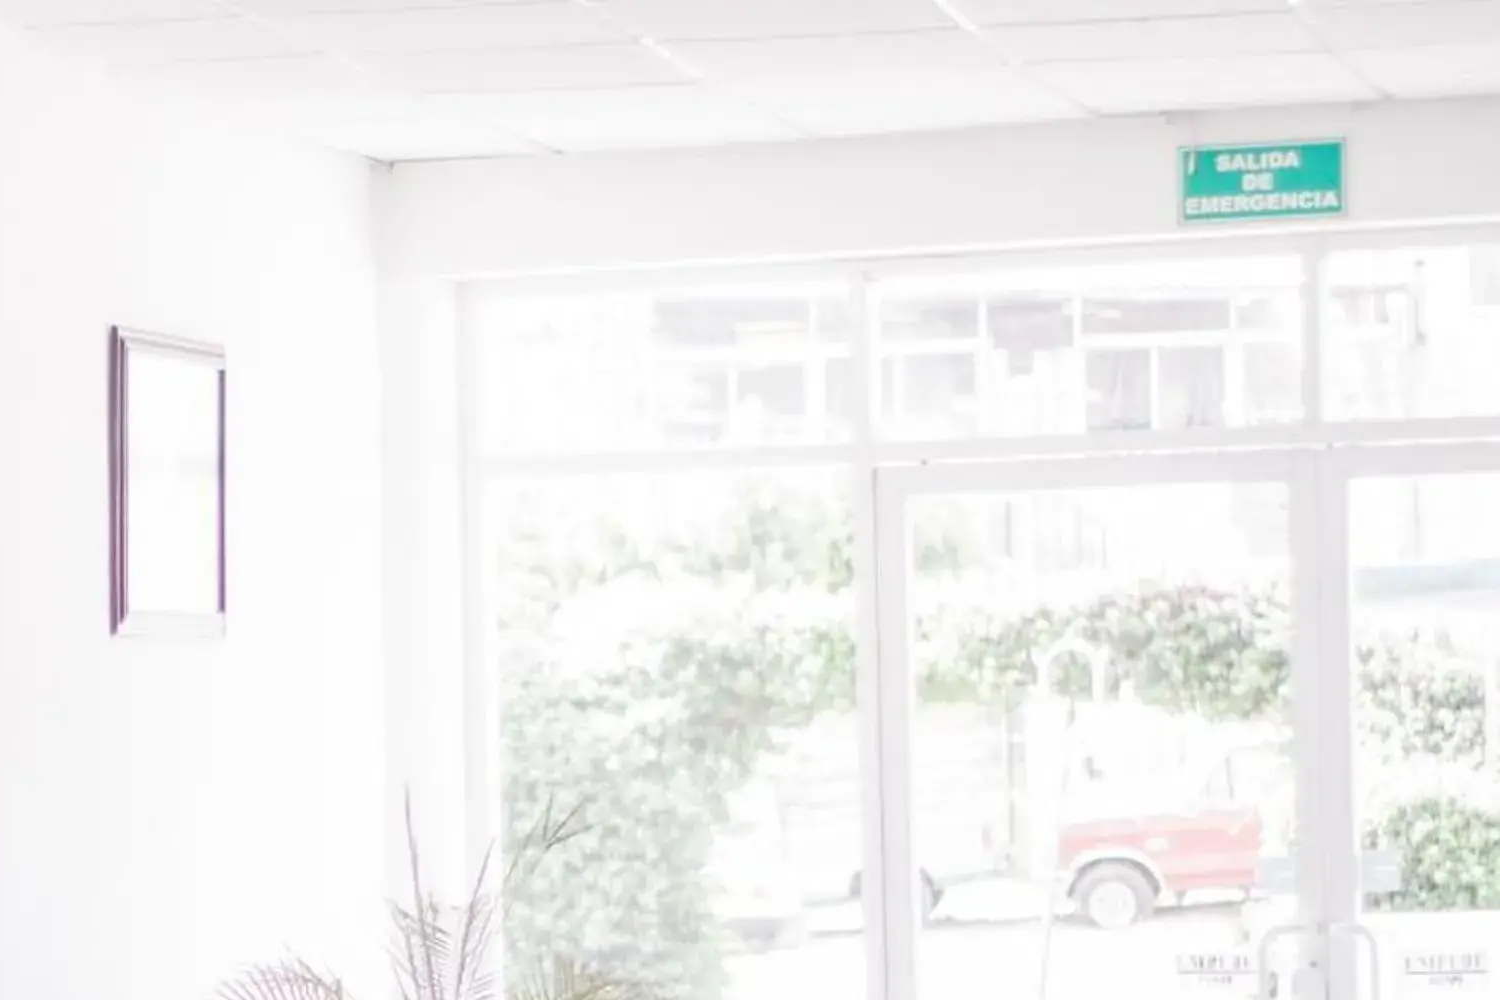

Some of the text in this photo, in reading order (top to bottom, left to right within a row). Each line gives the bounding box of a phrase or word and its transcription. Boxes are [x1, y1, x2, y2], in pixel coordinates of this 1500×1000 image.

[1215, 151, 1299, 172] SALIDA
[1242, 173, 1273, 191] DE
[1185, 191, 1338, 214] EMERGENCIA
